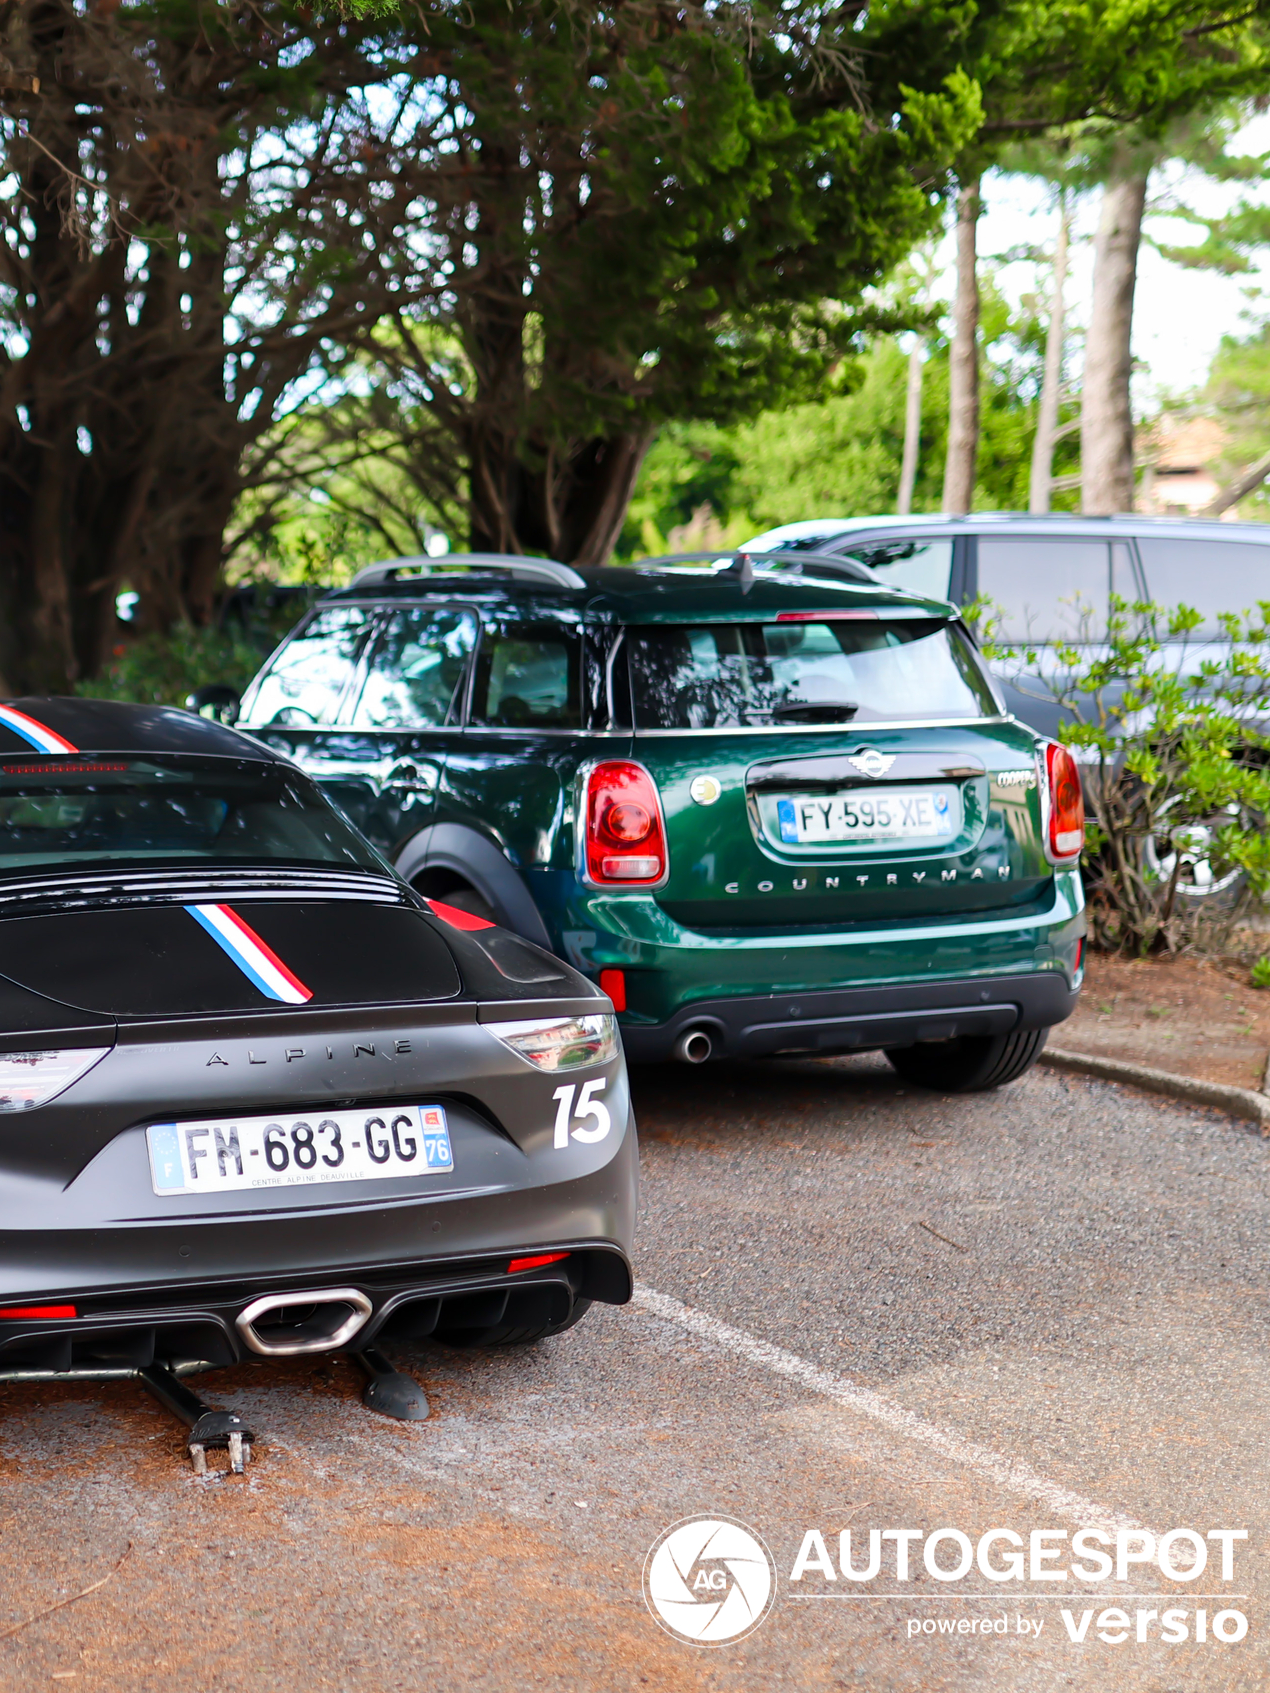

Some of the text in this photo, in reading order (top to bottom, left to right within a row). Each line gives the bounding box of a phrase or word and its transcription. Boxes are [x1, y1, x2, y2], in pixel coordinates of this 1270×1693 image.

[725, 866, 1011, 893] COUNTRYMAN
[205, 1039, 412, 1066] ALPINE
[552, 1077, 611, 1149] 15
[184, 1114, 417, 1179] FM-683-GG
[425, 1139, 449, 1162] 76
[164, 1162, 173, 1178] F
[251, 1171, 365, 1187] CENTRE ALPINE DEAUVILLE
